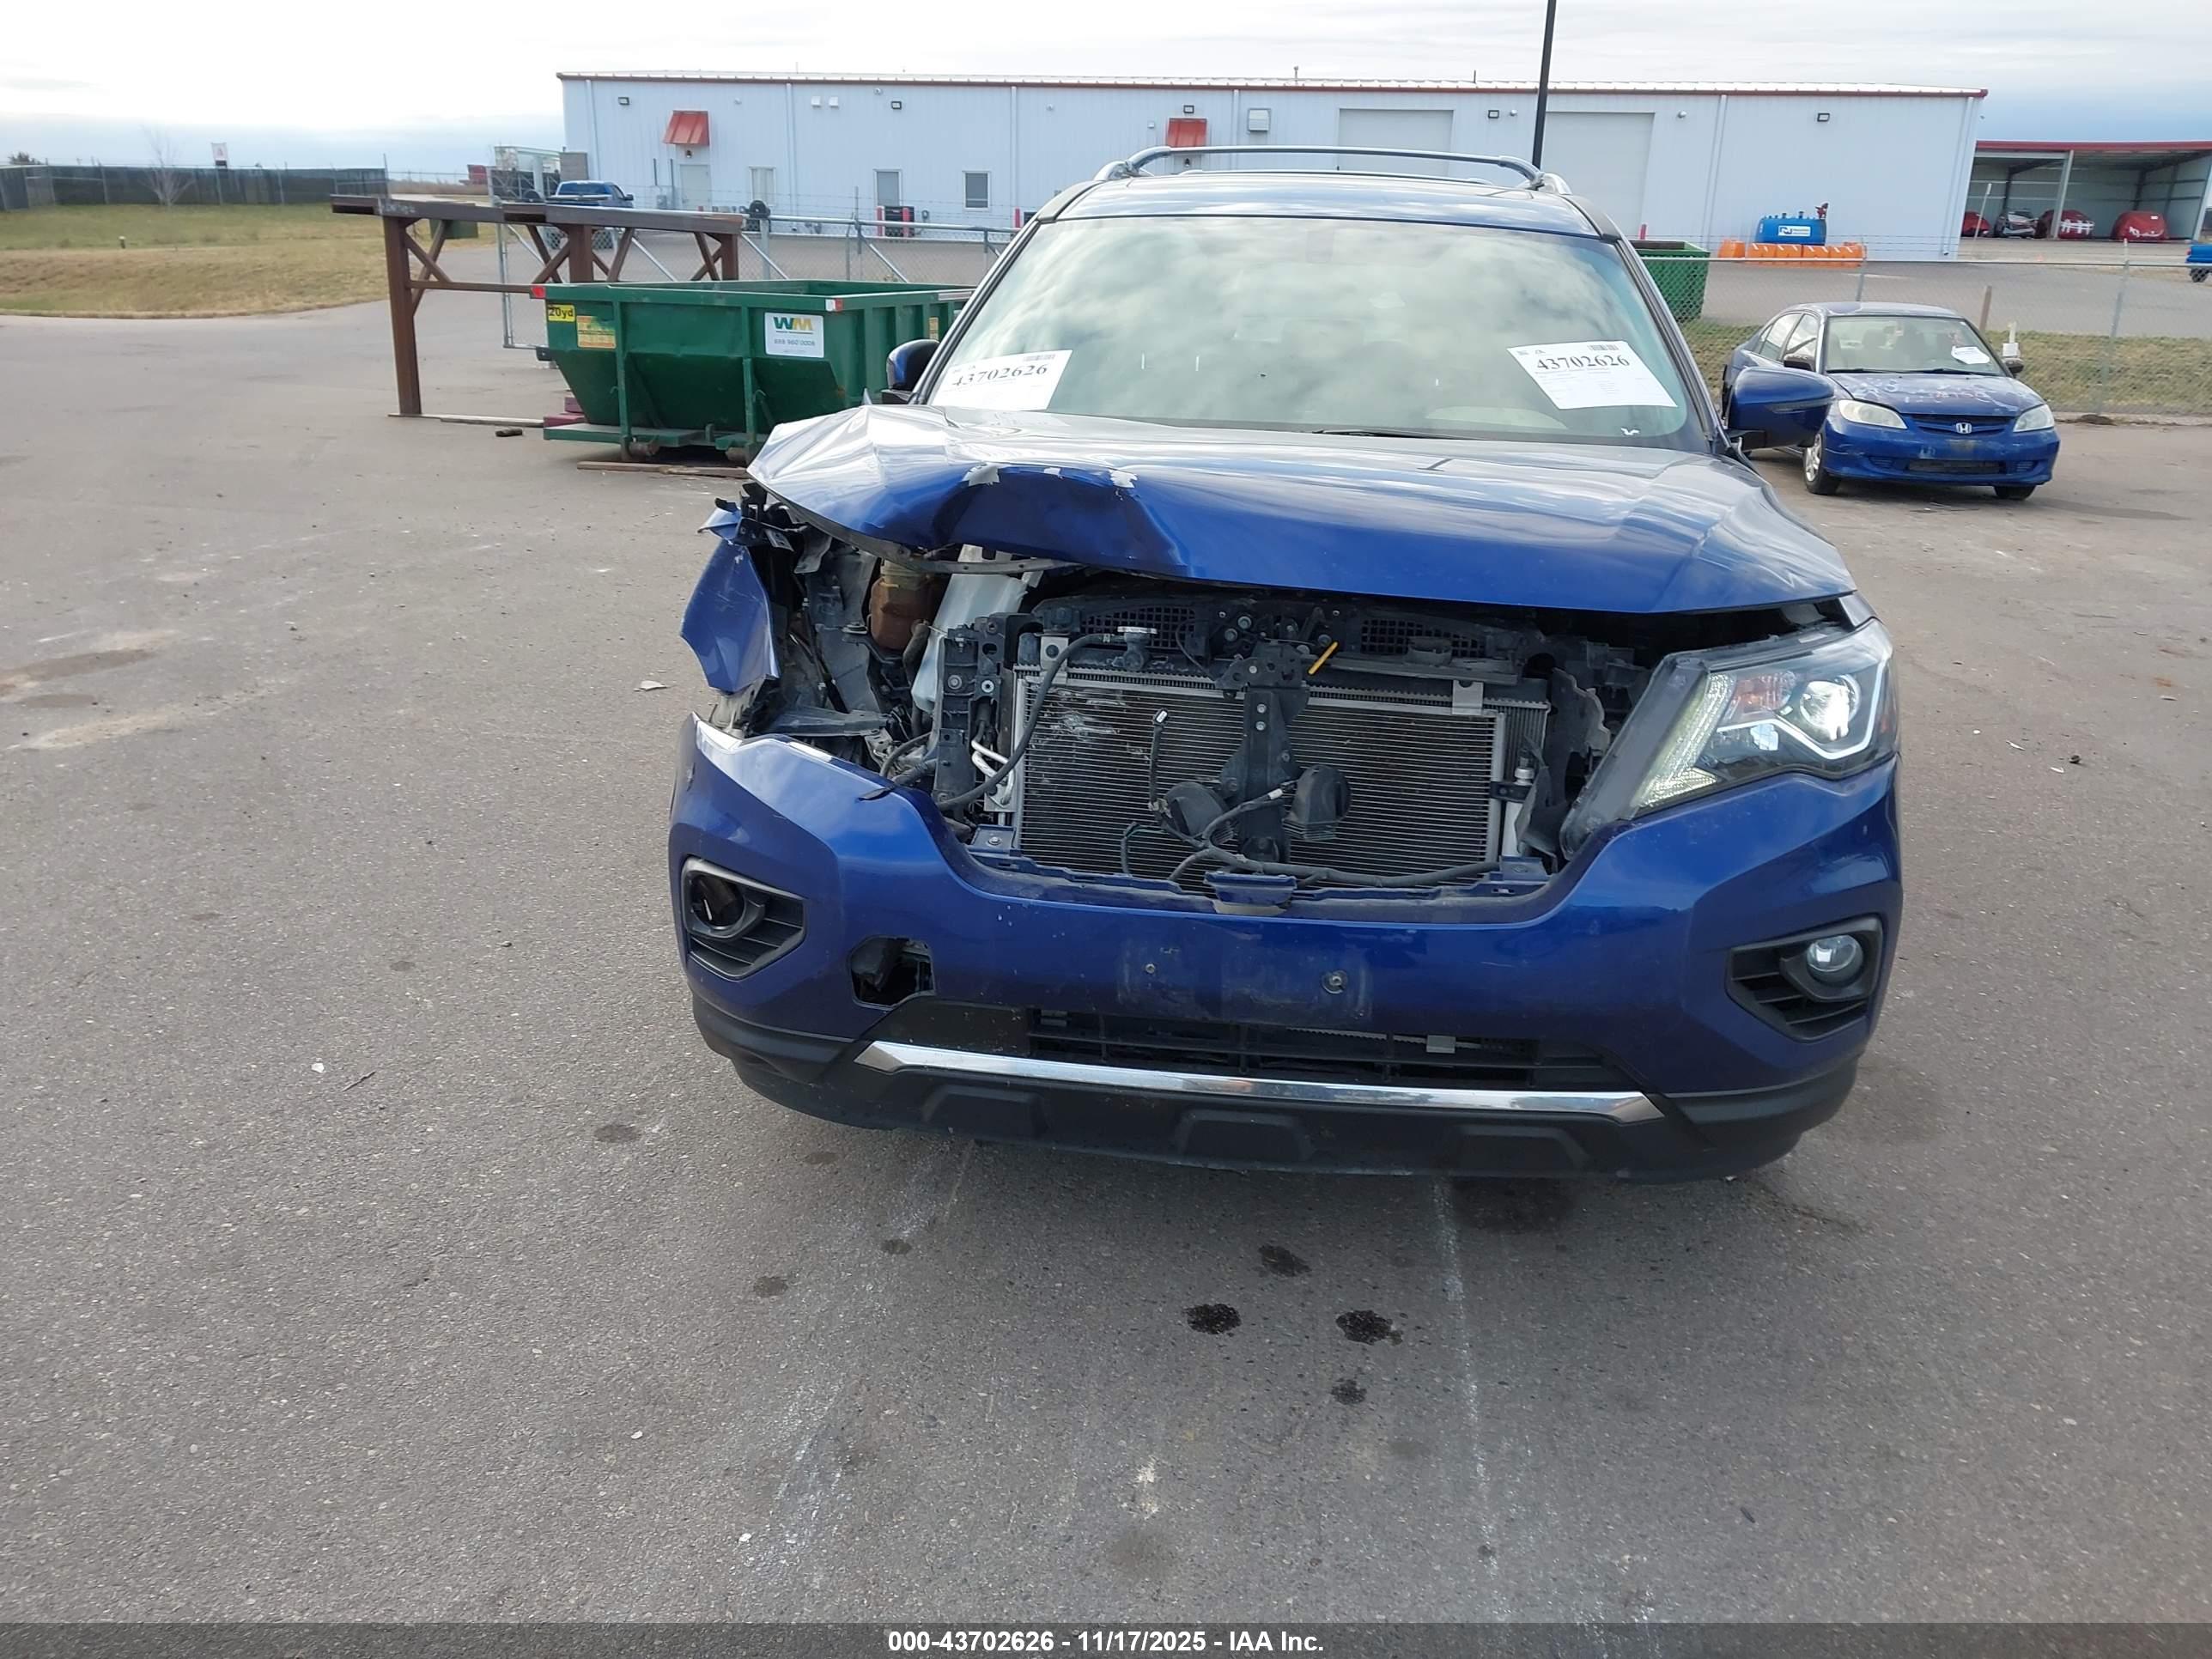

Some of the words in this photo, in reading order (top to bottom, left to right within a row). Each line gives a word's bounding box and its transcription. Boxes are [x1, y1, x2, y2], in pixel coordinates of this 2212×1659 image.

[548, 307, 574, 319] 20yd
[774, 317, 813, 331] WM
[1537, 355, 1630, 369] 43702626
